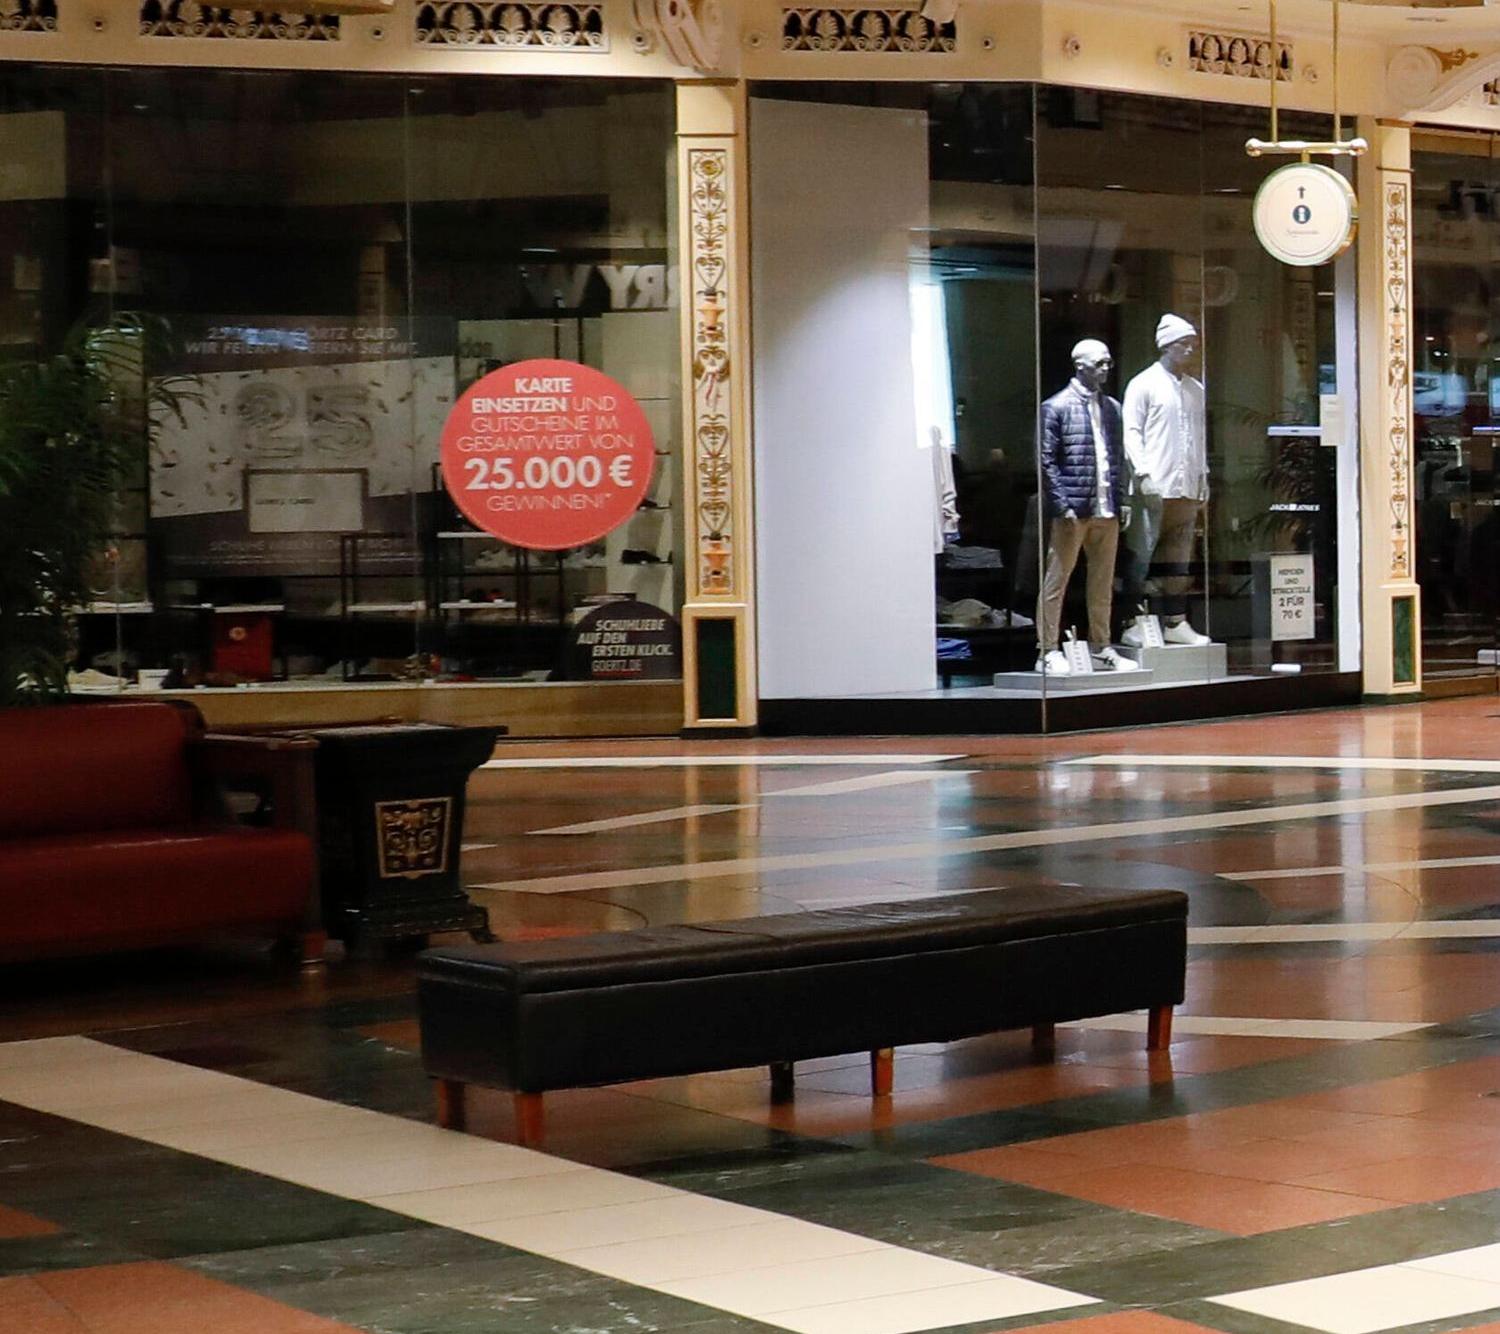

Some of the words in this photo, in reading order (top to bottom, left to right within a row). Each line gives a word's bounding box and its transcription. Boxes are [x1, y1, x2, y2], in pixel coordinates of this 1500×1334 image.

[515, 377, 573, 394] KARTE
[472, 397, 567, 414] EINSETZEN
[572, 395, 617, 412] UND
[471, 415, 590, 433] GUTSCHEINE
[596, 414, 619, 430] IM
[456, 434, 586, 453] GESAMTWERT
[589, 433, 635, 449] VON
[464, 455, 602, 491] 25.000
[608, 454, 634, 488] €
[1279, 597, 1285, 607] 2
[1287, 595, 1305, 607] FÜR
[1282, 609, 1293, 619] 70
[595, 618, 666, 632] SCHUHLIEBE
[576, 631, 602, 645] AUF
[602, 631, 628, 644] DEN
[592, 644, 636, 657] ERSTEN
